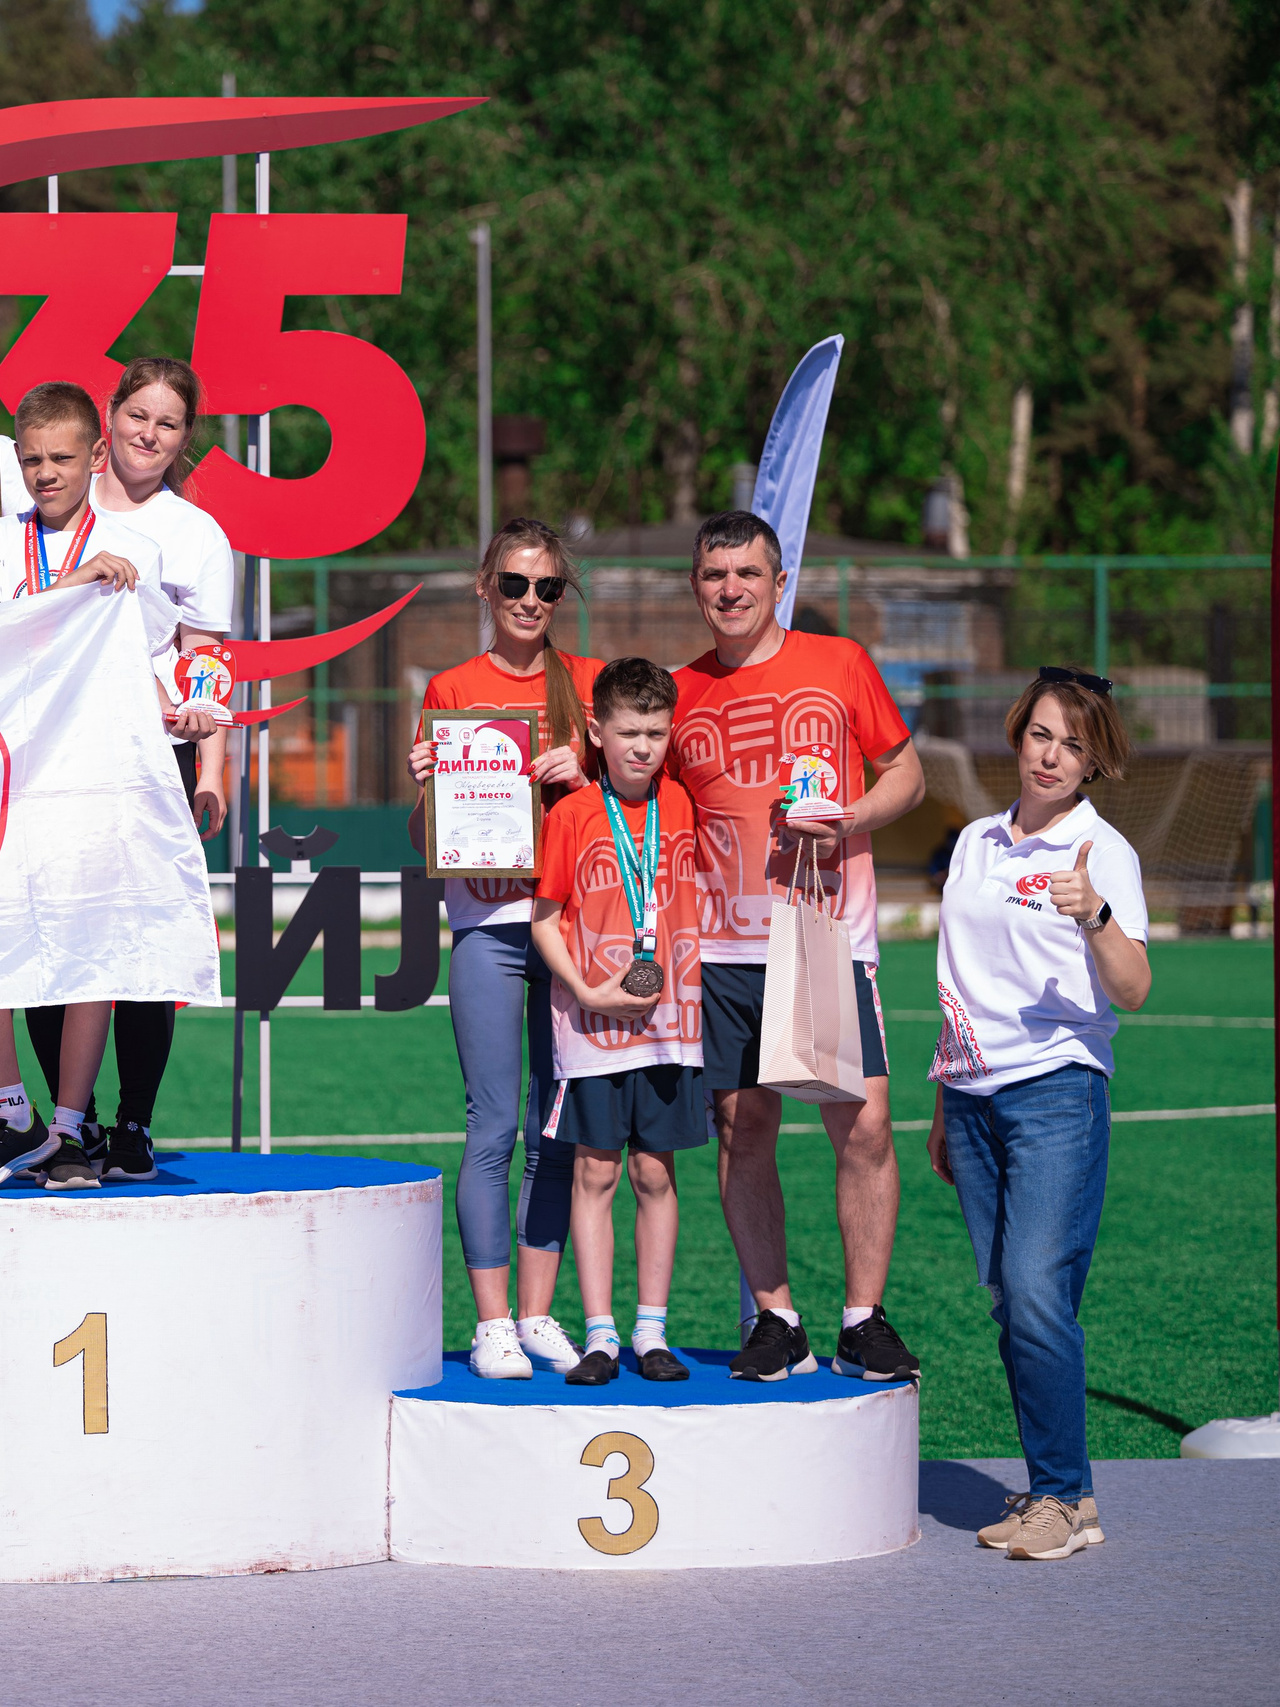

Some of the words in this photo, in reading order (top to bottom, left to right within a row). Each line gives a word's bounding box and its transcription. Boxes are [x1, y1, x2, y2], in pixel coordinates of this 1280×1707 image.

[437, 759, 516, 774] ДИПЛОМ
[469, 791, 476, 800] 3
[779, 785, 799, 810] 3
[1026, 874, 1051, 890] 35
[1005, 896, 1043, 911] ЛУКОЙЛ
[52, 1311, 110, 1435] 1
[577, 1430, 660, 1555] 3
